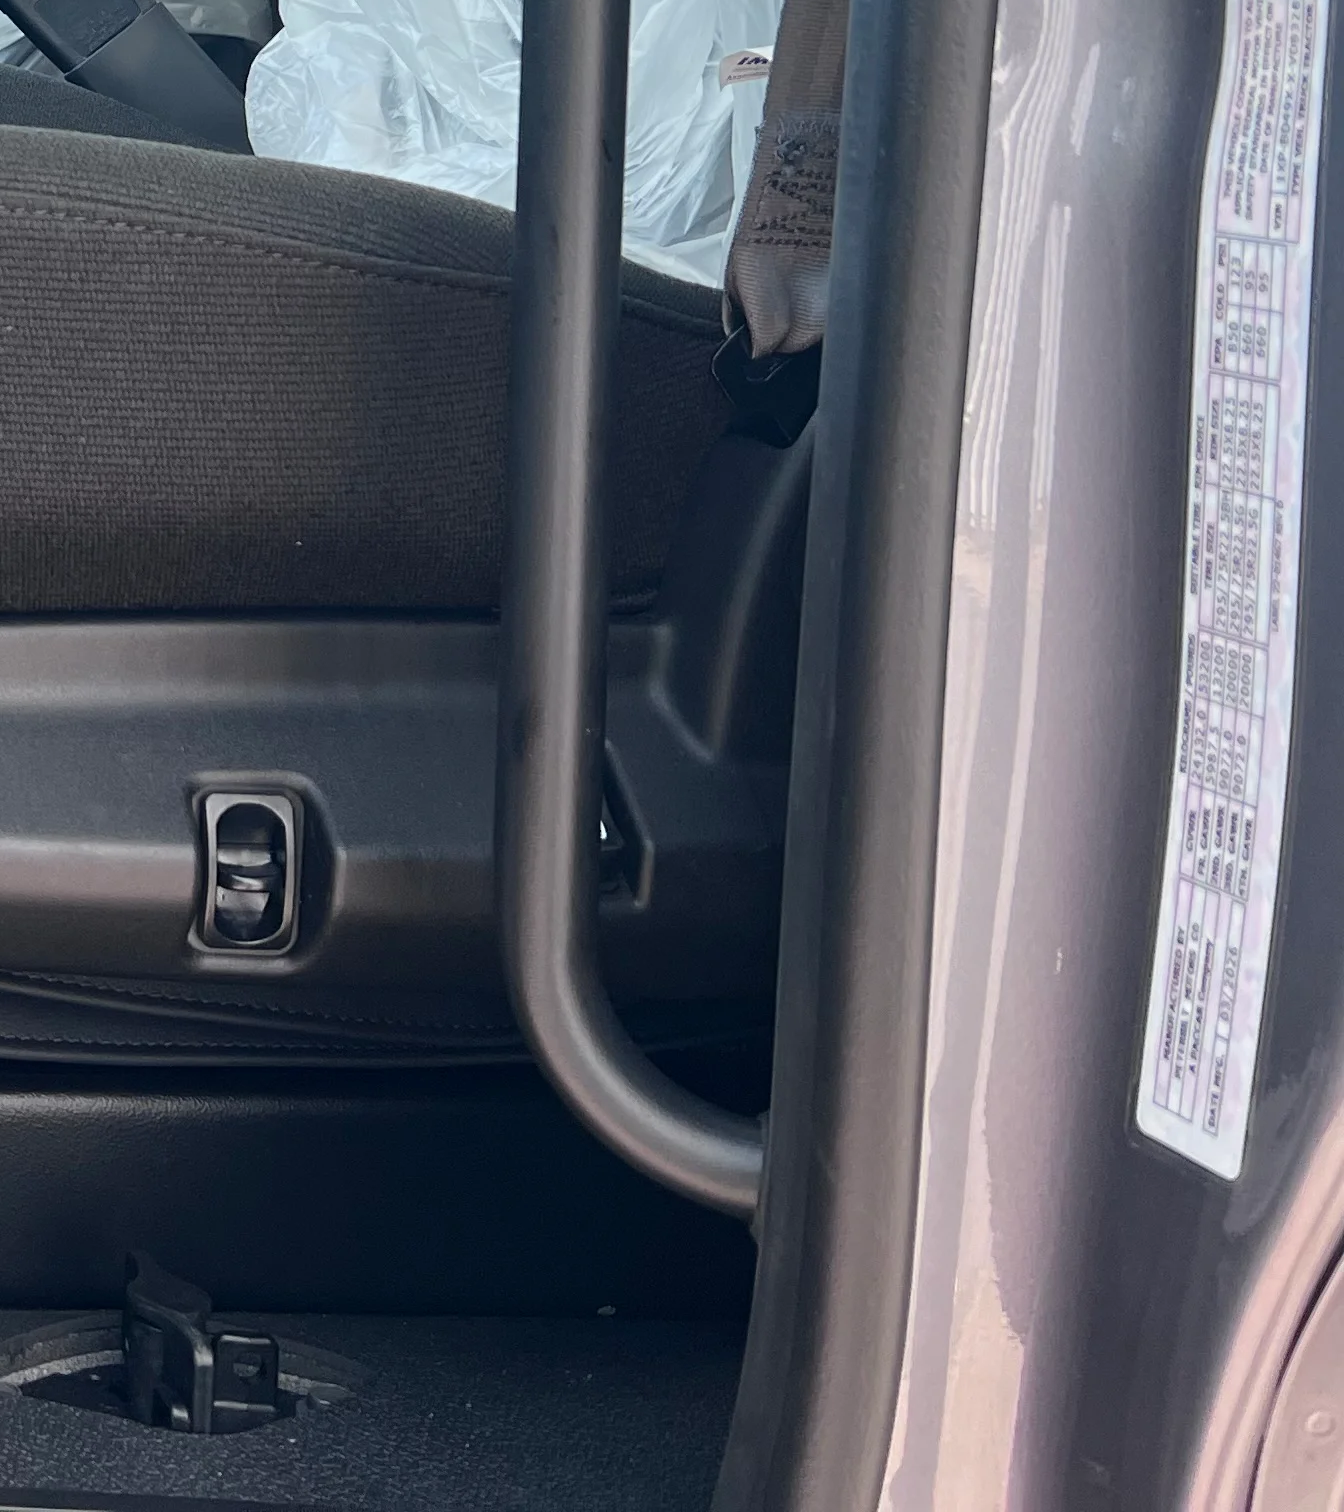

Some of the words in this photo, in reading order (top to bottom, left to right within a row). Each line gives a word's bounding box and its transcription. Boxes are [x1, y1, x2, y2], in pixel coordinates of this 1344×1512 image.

[1245, 16, 1252, 33] TO
[1266, 2, 1273, 22] ON
[1262, 26, 1272, 70] EFFECT
[1267, 23, 1281, 116] MANUFACTURE
[1236, 39, 1250, 109] CONFORMS
[1291, 163, 1301, 196] TYPE
[1298, 74, 1308, 120] TRUCK
[1304, 4, 1313, 68] TRACTOR
[1228, 114, 1240, 164] VEHICLE
[1234, 143, 1247, 216] APPLICABLE
[1242, 86, 1255, 137] FEDERAL
[1251, 34, 1260, 79] MOTOR
[1249, 94, 1266, 170] STANDARDS
[1264, 122, 1271, 137] OF
[1260, 143, 1269, 174] DATE
[1223, 170, 1234, 197] THIS
[1245, 174, 1255, 220] SAFETY
[1231, 256, 1241, 287] 123
[1244, 270, 1254, 291] 95
[1258, 272, 1269, 293] 95
[1216, 283, 1224, 321] COLD
[1242, 324, 1252, 355] 660
[1256, 326, 1267, 358] 660
[1196, 415, 1204, 460] CHOICE
[1198, 641, 1210, 694] 53200
[1213, 645, 1224, 696] 13200
[1226, 649, 1238, 702] 20000
[1240, 654, 1252, 708] 20000
[1180, 700, 1192, 773] KILOGRAMS
[1186, 633, 1195, 686] POUNDS
[1191, 922, 1200, 943] CO
[1163, 948, 1182, 1060] MANUFACTURED
[1177, 926, 1185, 945] BY
[1190, 1006, 1202, 1060] PACCAR
[1208, 1093, 1218, 1127] DATE
